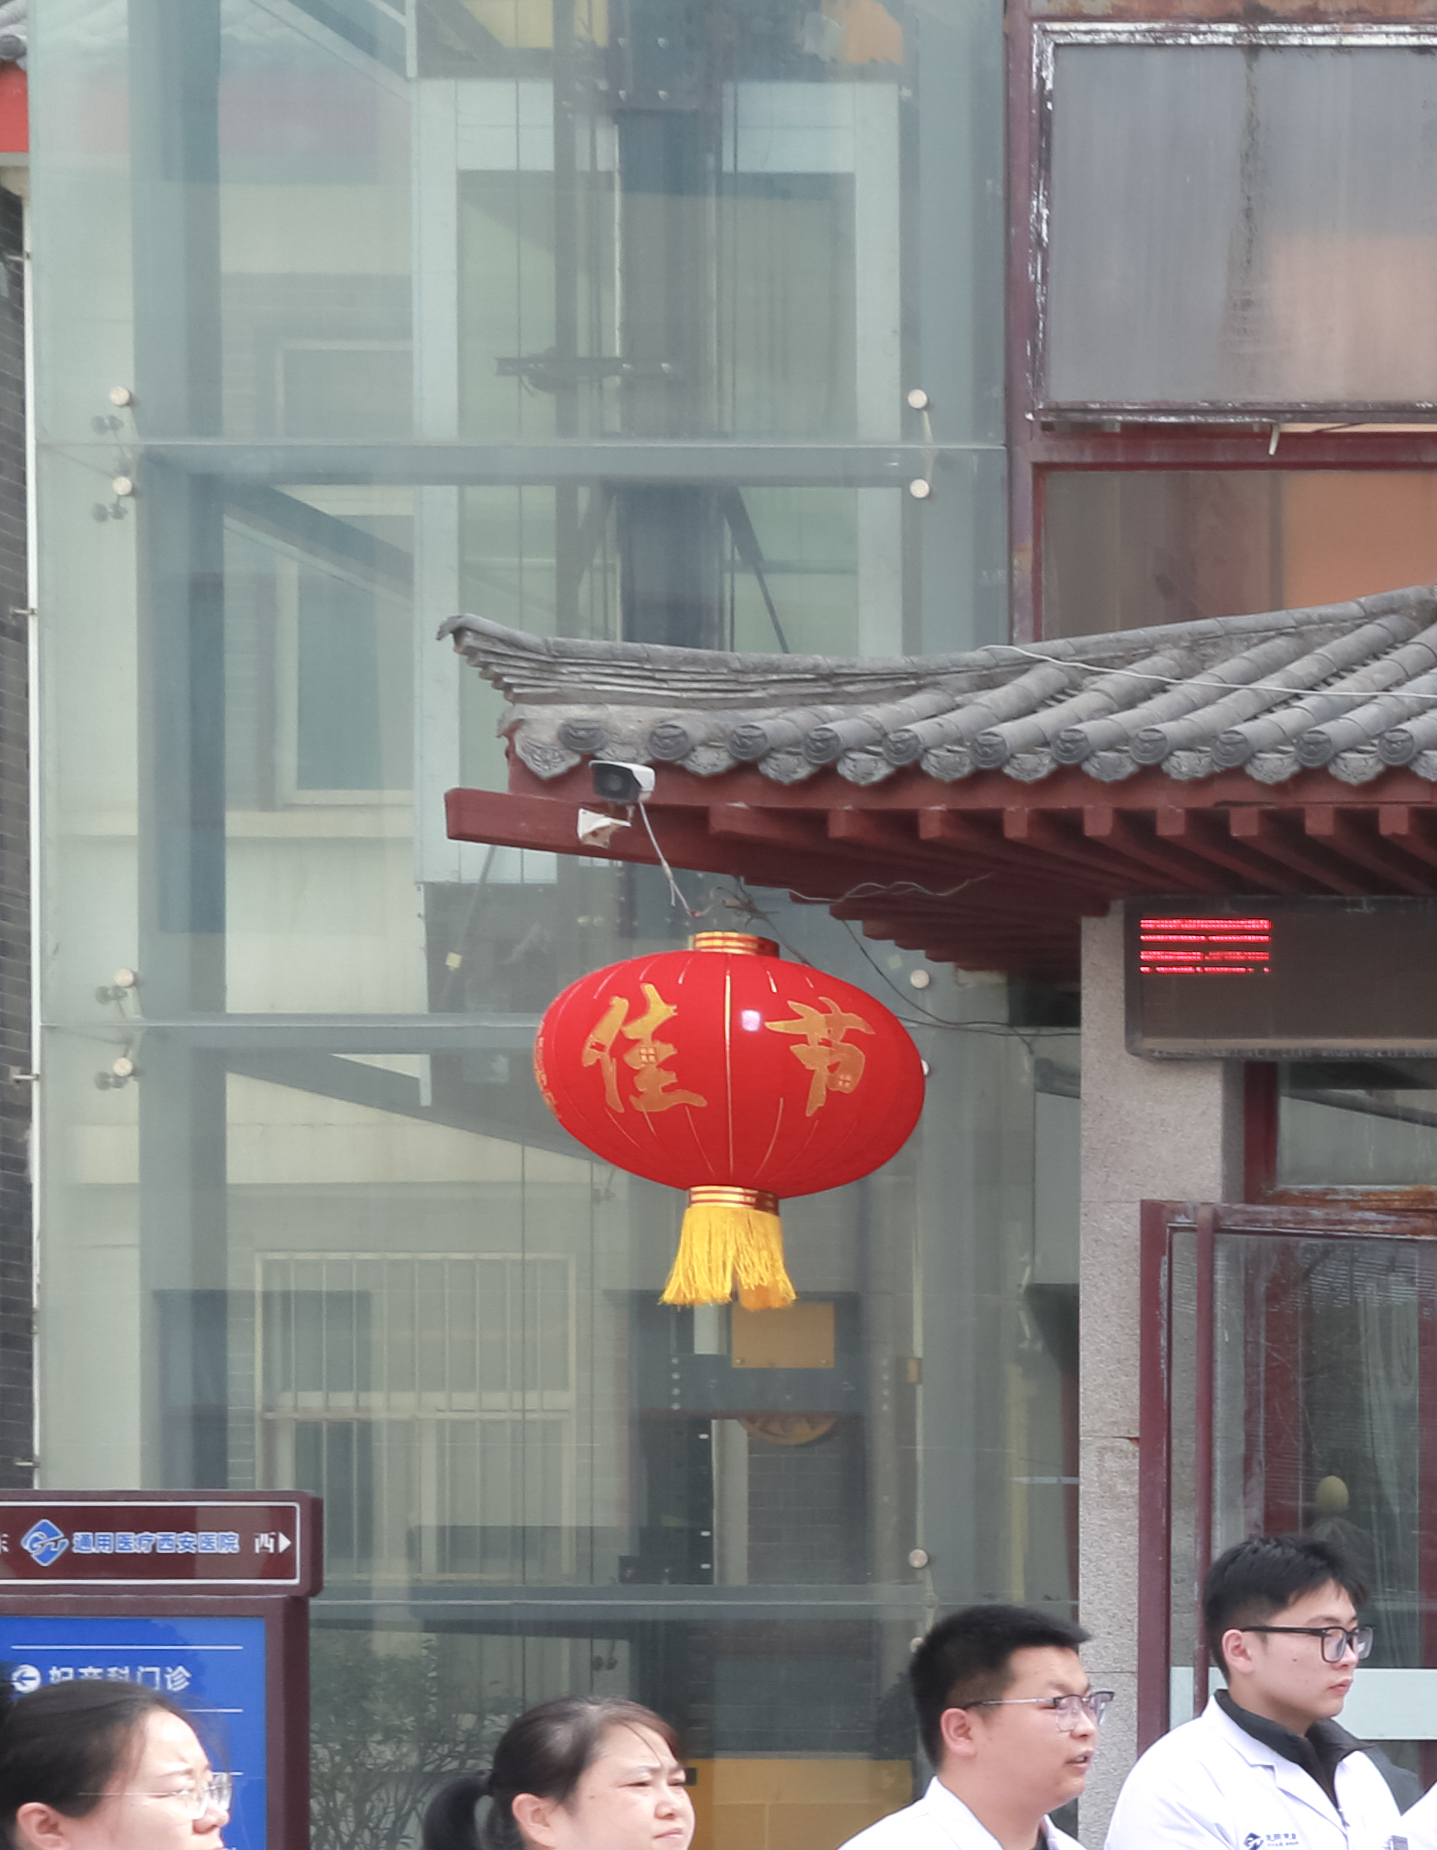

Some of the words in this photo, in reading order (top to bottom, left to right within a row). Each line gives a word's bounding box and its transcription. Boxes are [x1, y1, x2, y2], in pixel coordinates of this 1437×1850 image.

[72, 1531, 241, 1555] 通用医疗西安医院
[254, 1532, 275, 1554] 西
